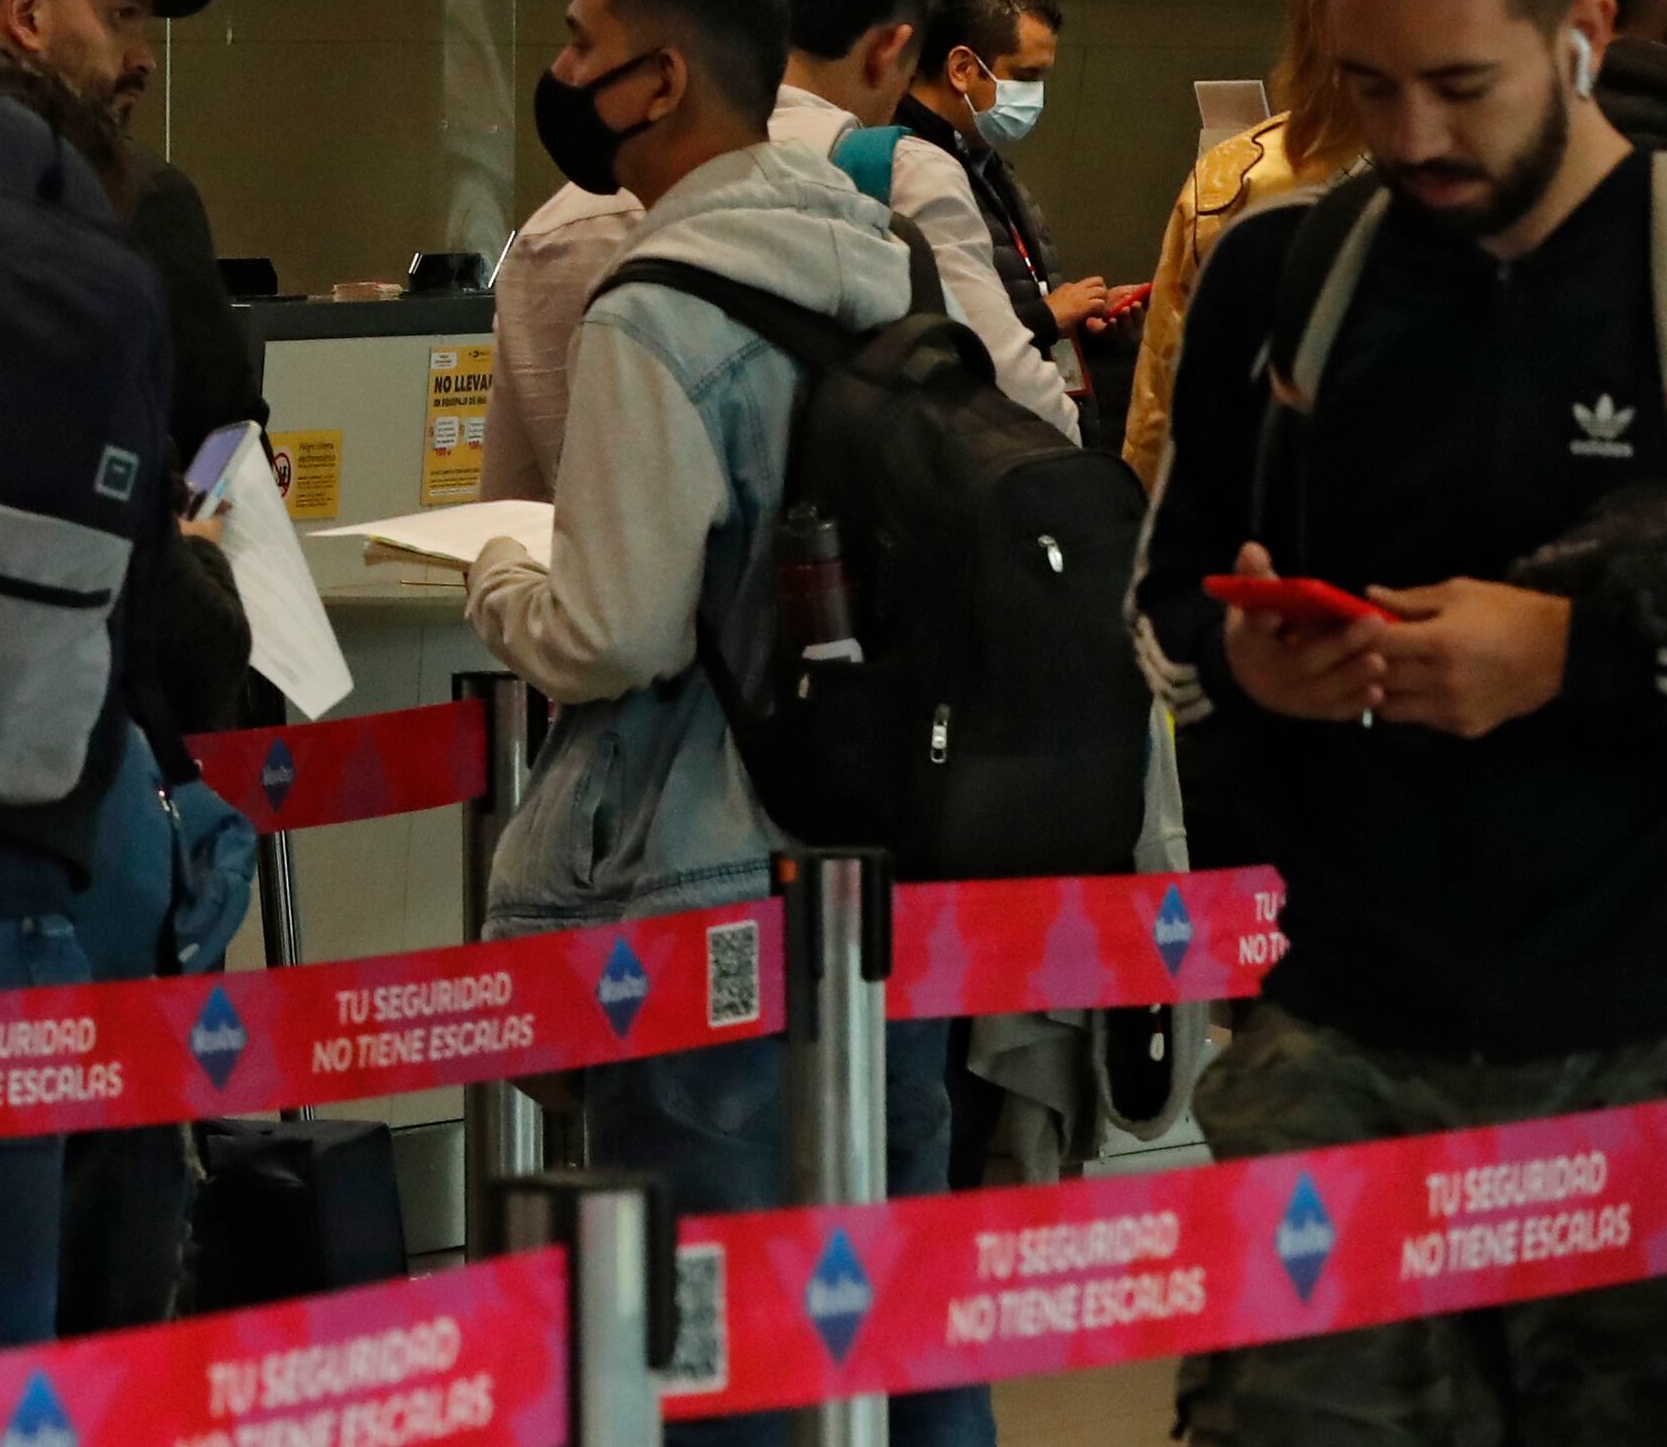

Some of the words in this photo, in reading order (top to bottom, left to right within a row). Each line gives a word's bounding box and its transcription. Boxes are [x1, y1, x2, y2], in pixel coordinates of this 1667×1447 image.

[434, 375, 452, 393] NO
[1254, 891, 1278, 924] TU
[1239, 933, 1267, 966] NO
[335, 989, 371, 1024] TU
[374, 972, 512, 1021] SEGURIDAD
[312, 1040, 354, 1075] NO
[357, 1032, 425, 1071] TIENE
[428, 1013, 535, 1064] ESCALAS
[8, 1062, 123, 1105] ESCALAS
[1425, 1171, 1462, 1218] TU
[1464, 1149, 1608, 1214] SEGURIDAD
[975, 1229, 1017, 1280] TU
[1017, 1209, 1180, 1277] SEGURIDAD
[1401, 1232, 1445, 1281] NO
[1446, 1220, 1519, 1273] TIENE
[1521, 1202, 1632, 1262] ESCALAS
[945, 1294, 997, 1345] NO
[207, 1359, 258, 1420] TU
